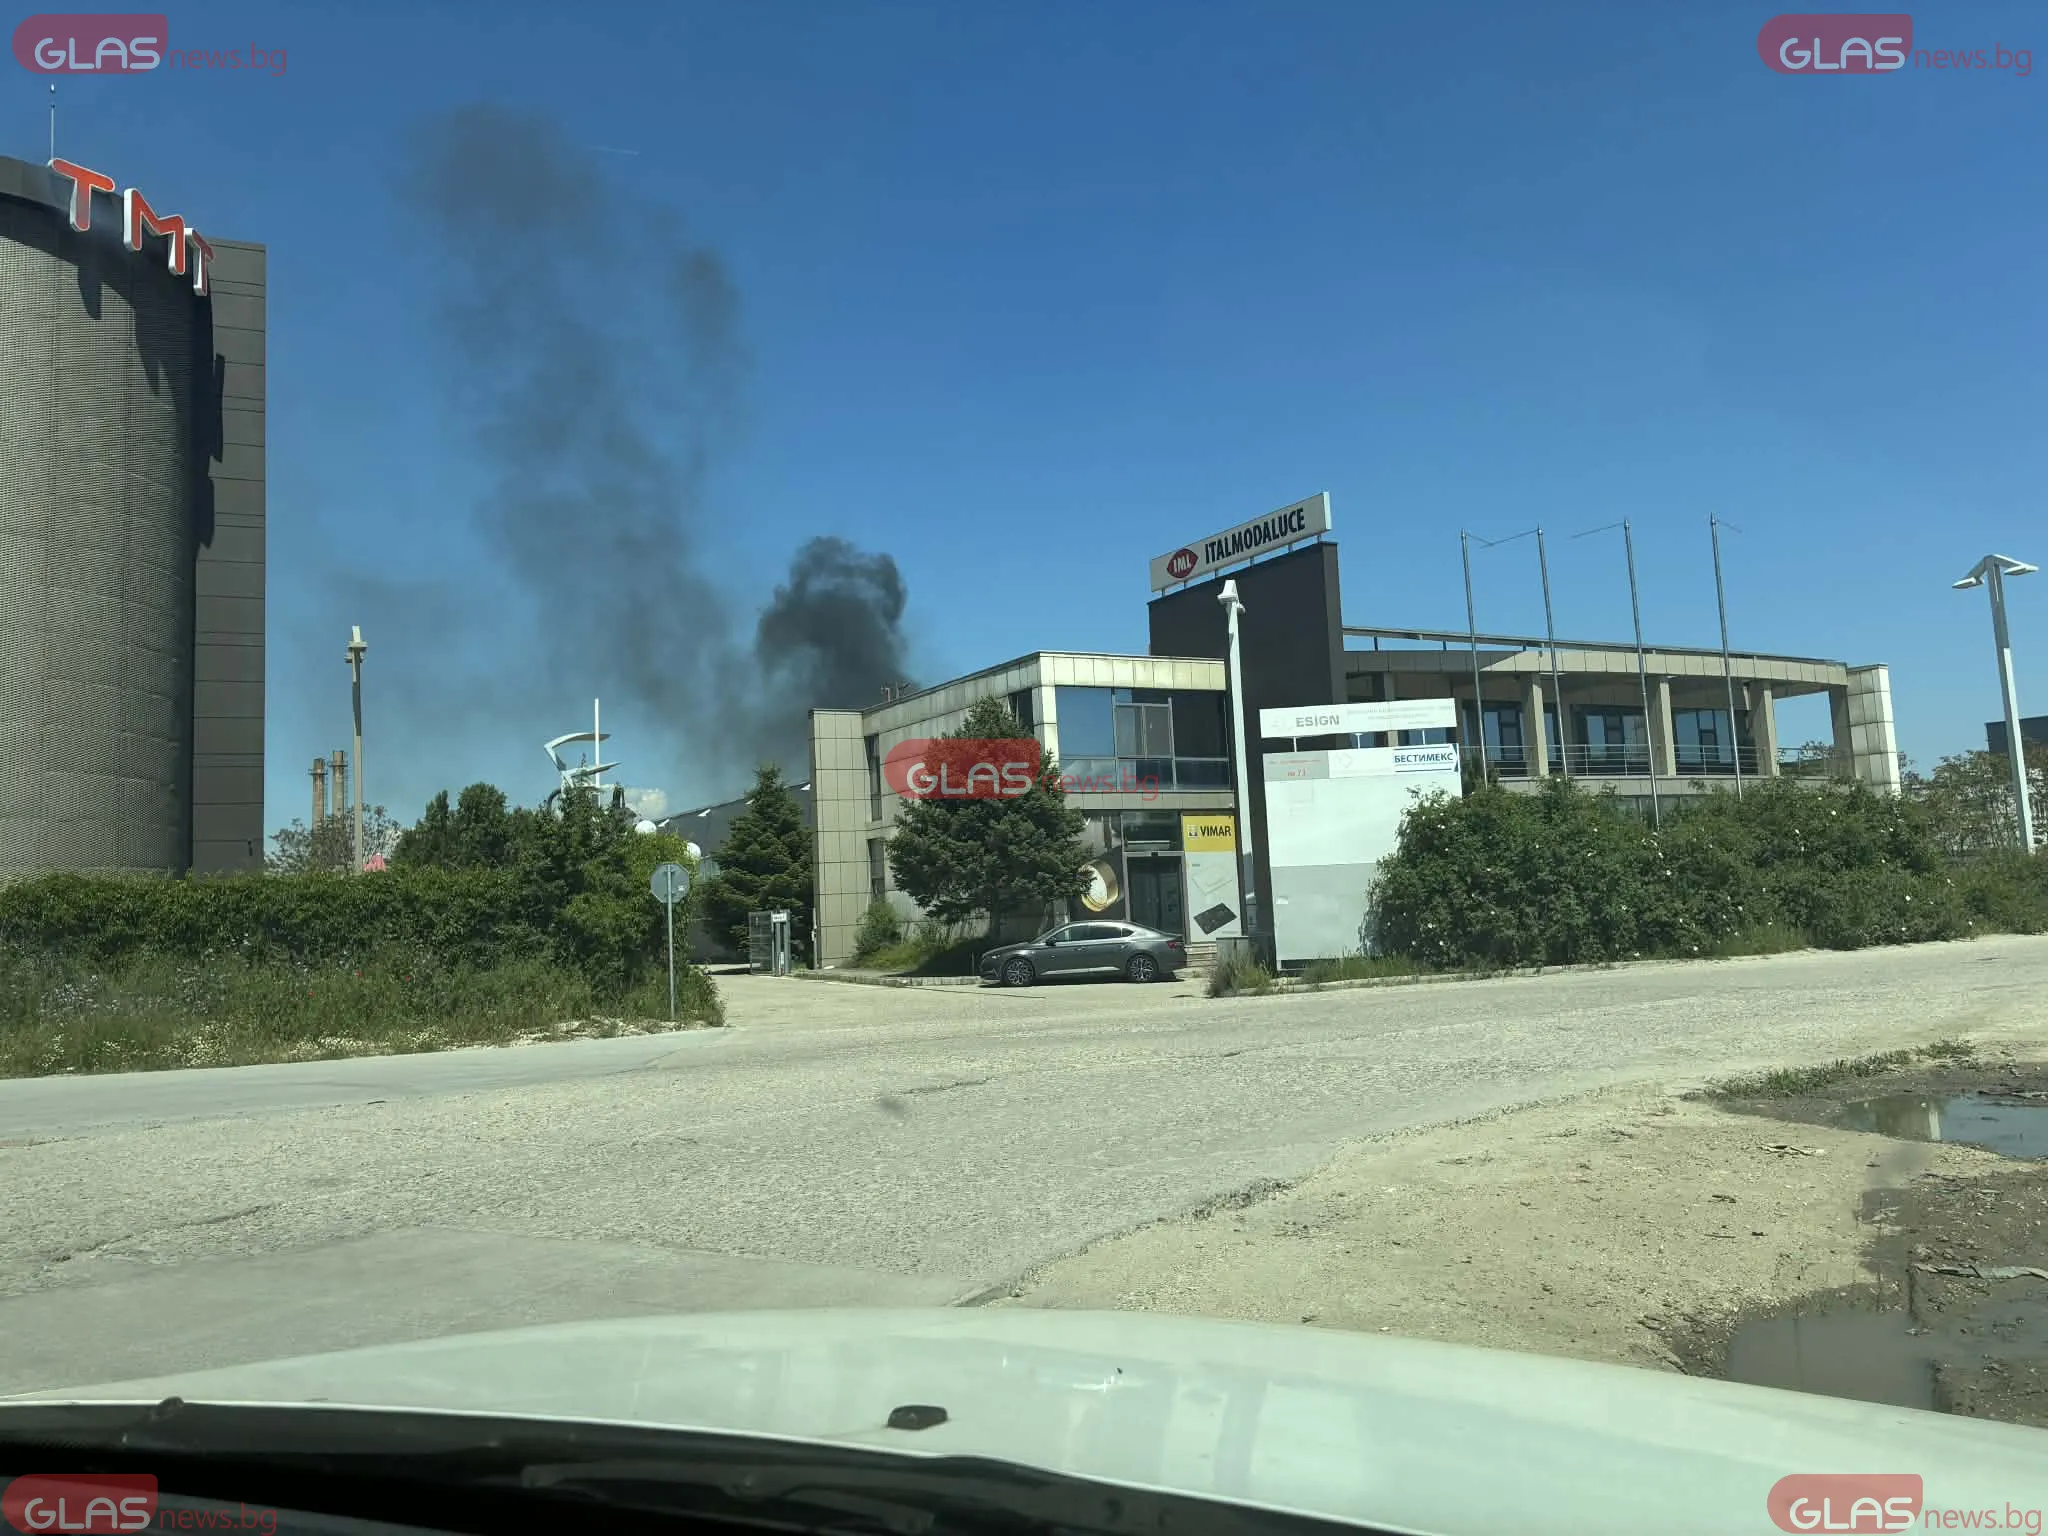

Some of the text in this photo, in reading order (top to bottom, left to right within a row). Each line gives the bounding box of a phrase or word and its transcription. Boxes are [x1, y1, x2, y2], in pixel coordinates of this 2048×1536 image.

[49, 158, 214, 297] TMT
[1173, 507, 1306, 573] IML ITALMODALUCE
[1394, 752, 1454, 764] БЕСТИМЕКС
[1200, 825, 1232, 838] VIMAR
